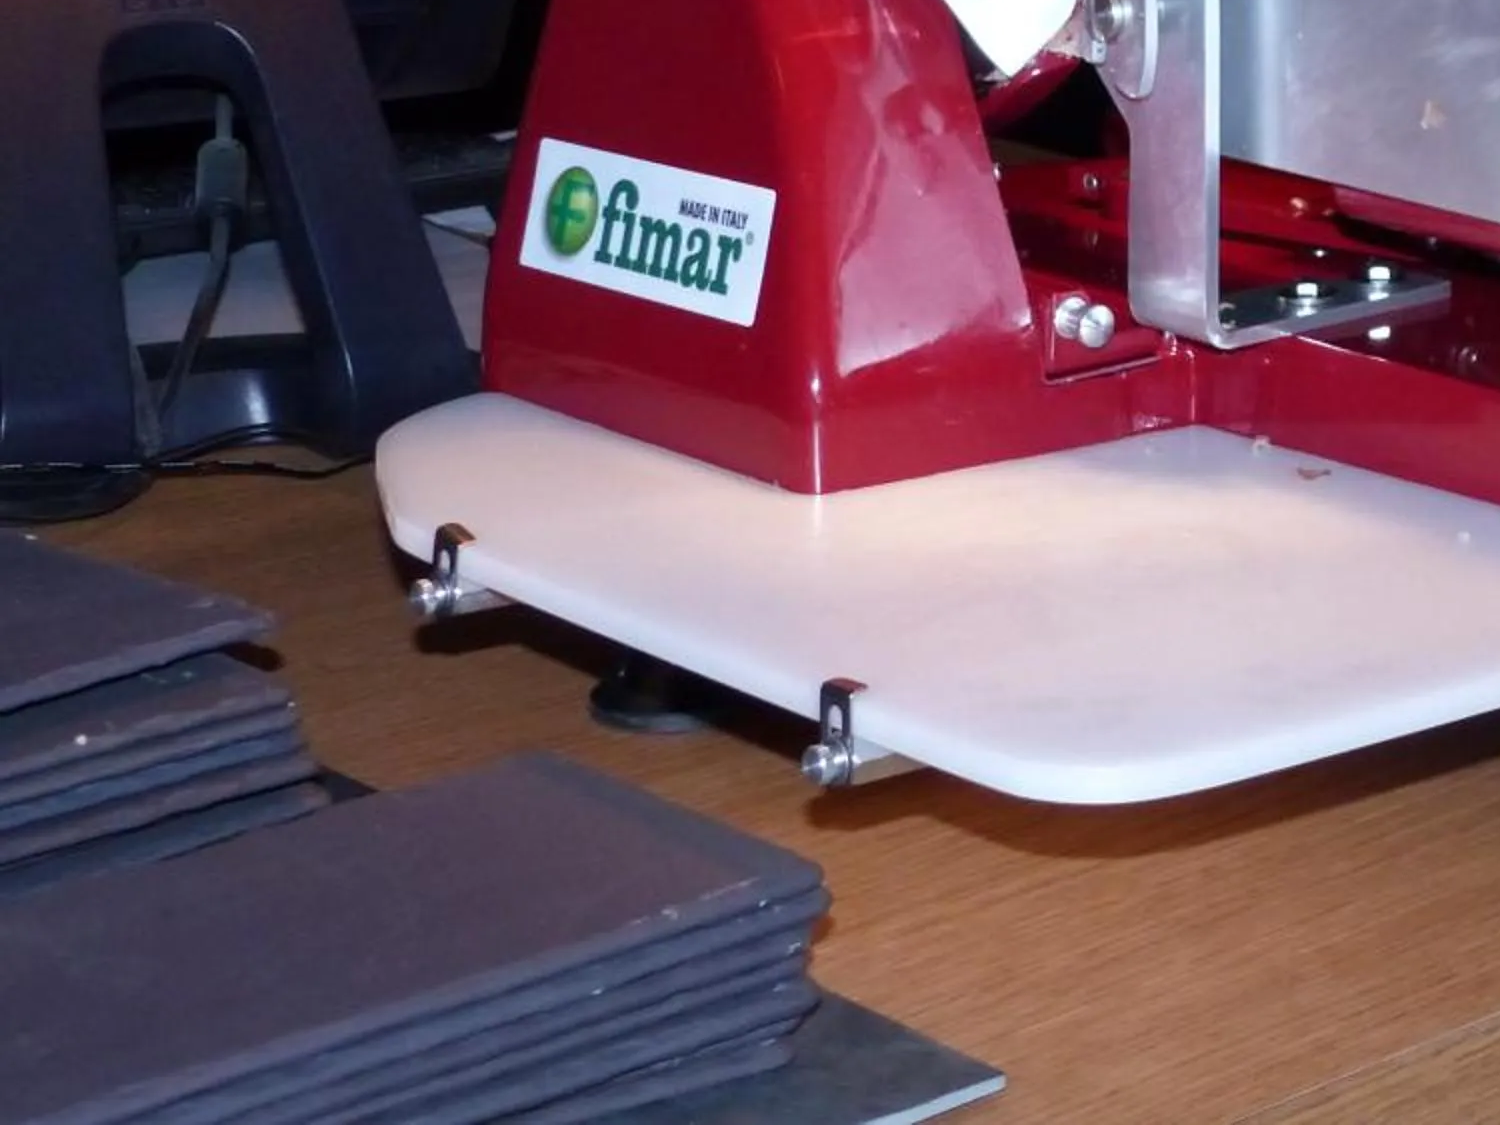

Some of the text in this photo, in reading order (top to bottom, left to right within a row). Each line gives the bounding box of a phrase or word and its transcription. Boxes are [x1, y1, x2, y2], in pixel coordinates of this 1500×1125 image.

[679, 198, 749, 230] MADE IN ITALY
